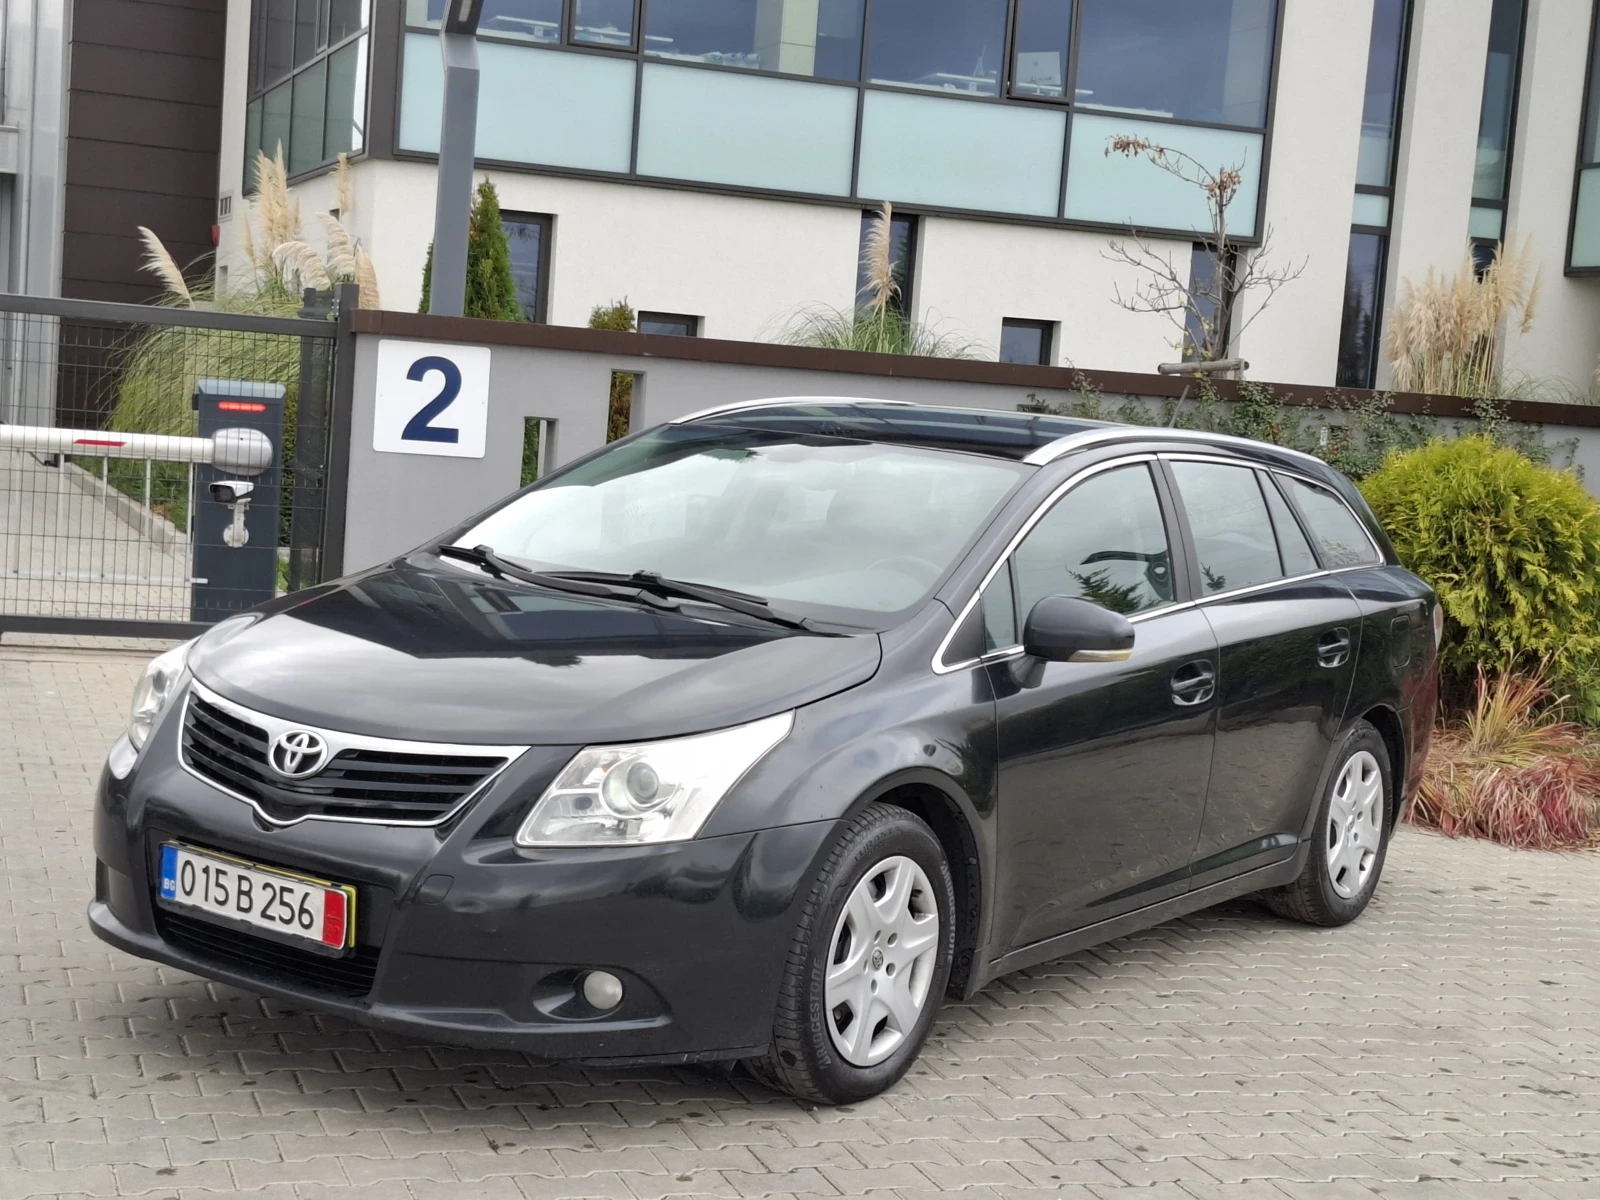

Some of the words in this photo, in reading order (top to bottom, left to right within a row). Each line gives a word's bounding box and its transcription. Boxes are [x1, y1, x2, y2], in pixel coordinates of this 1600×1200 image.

[401, 356, 462, 444] 2
[163, 877, 176, 891] BG
[809, 957, 832, 1070] BRIDGESTONE
